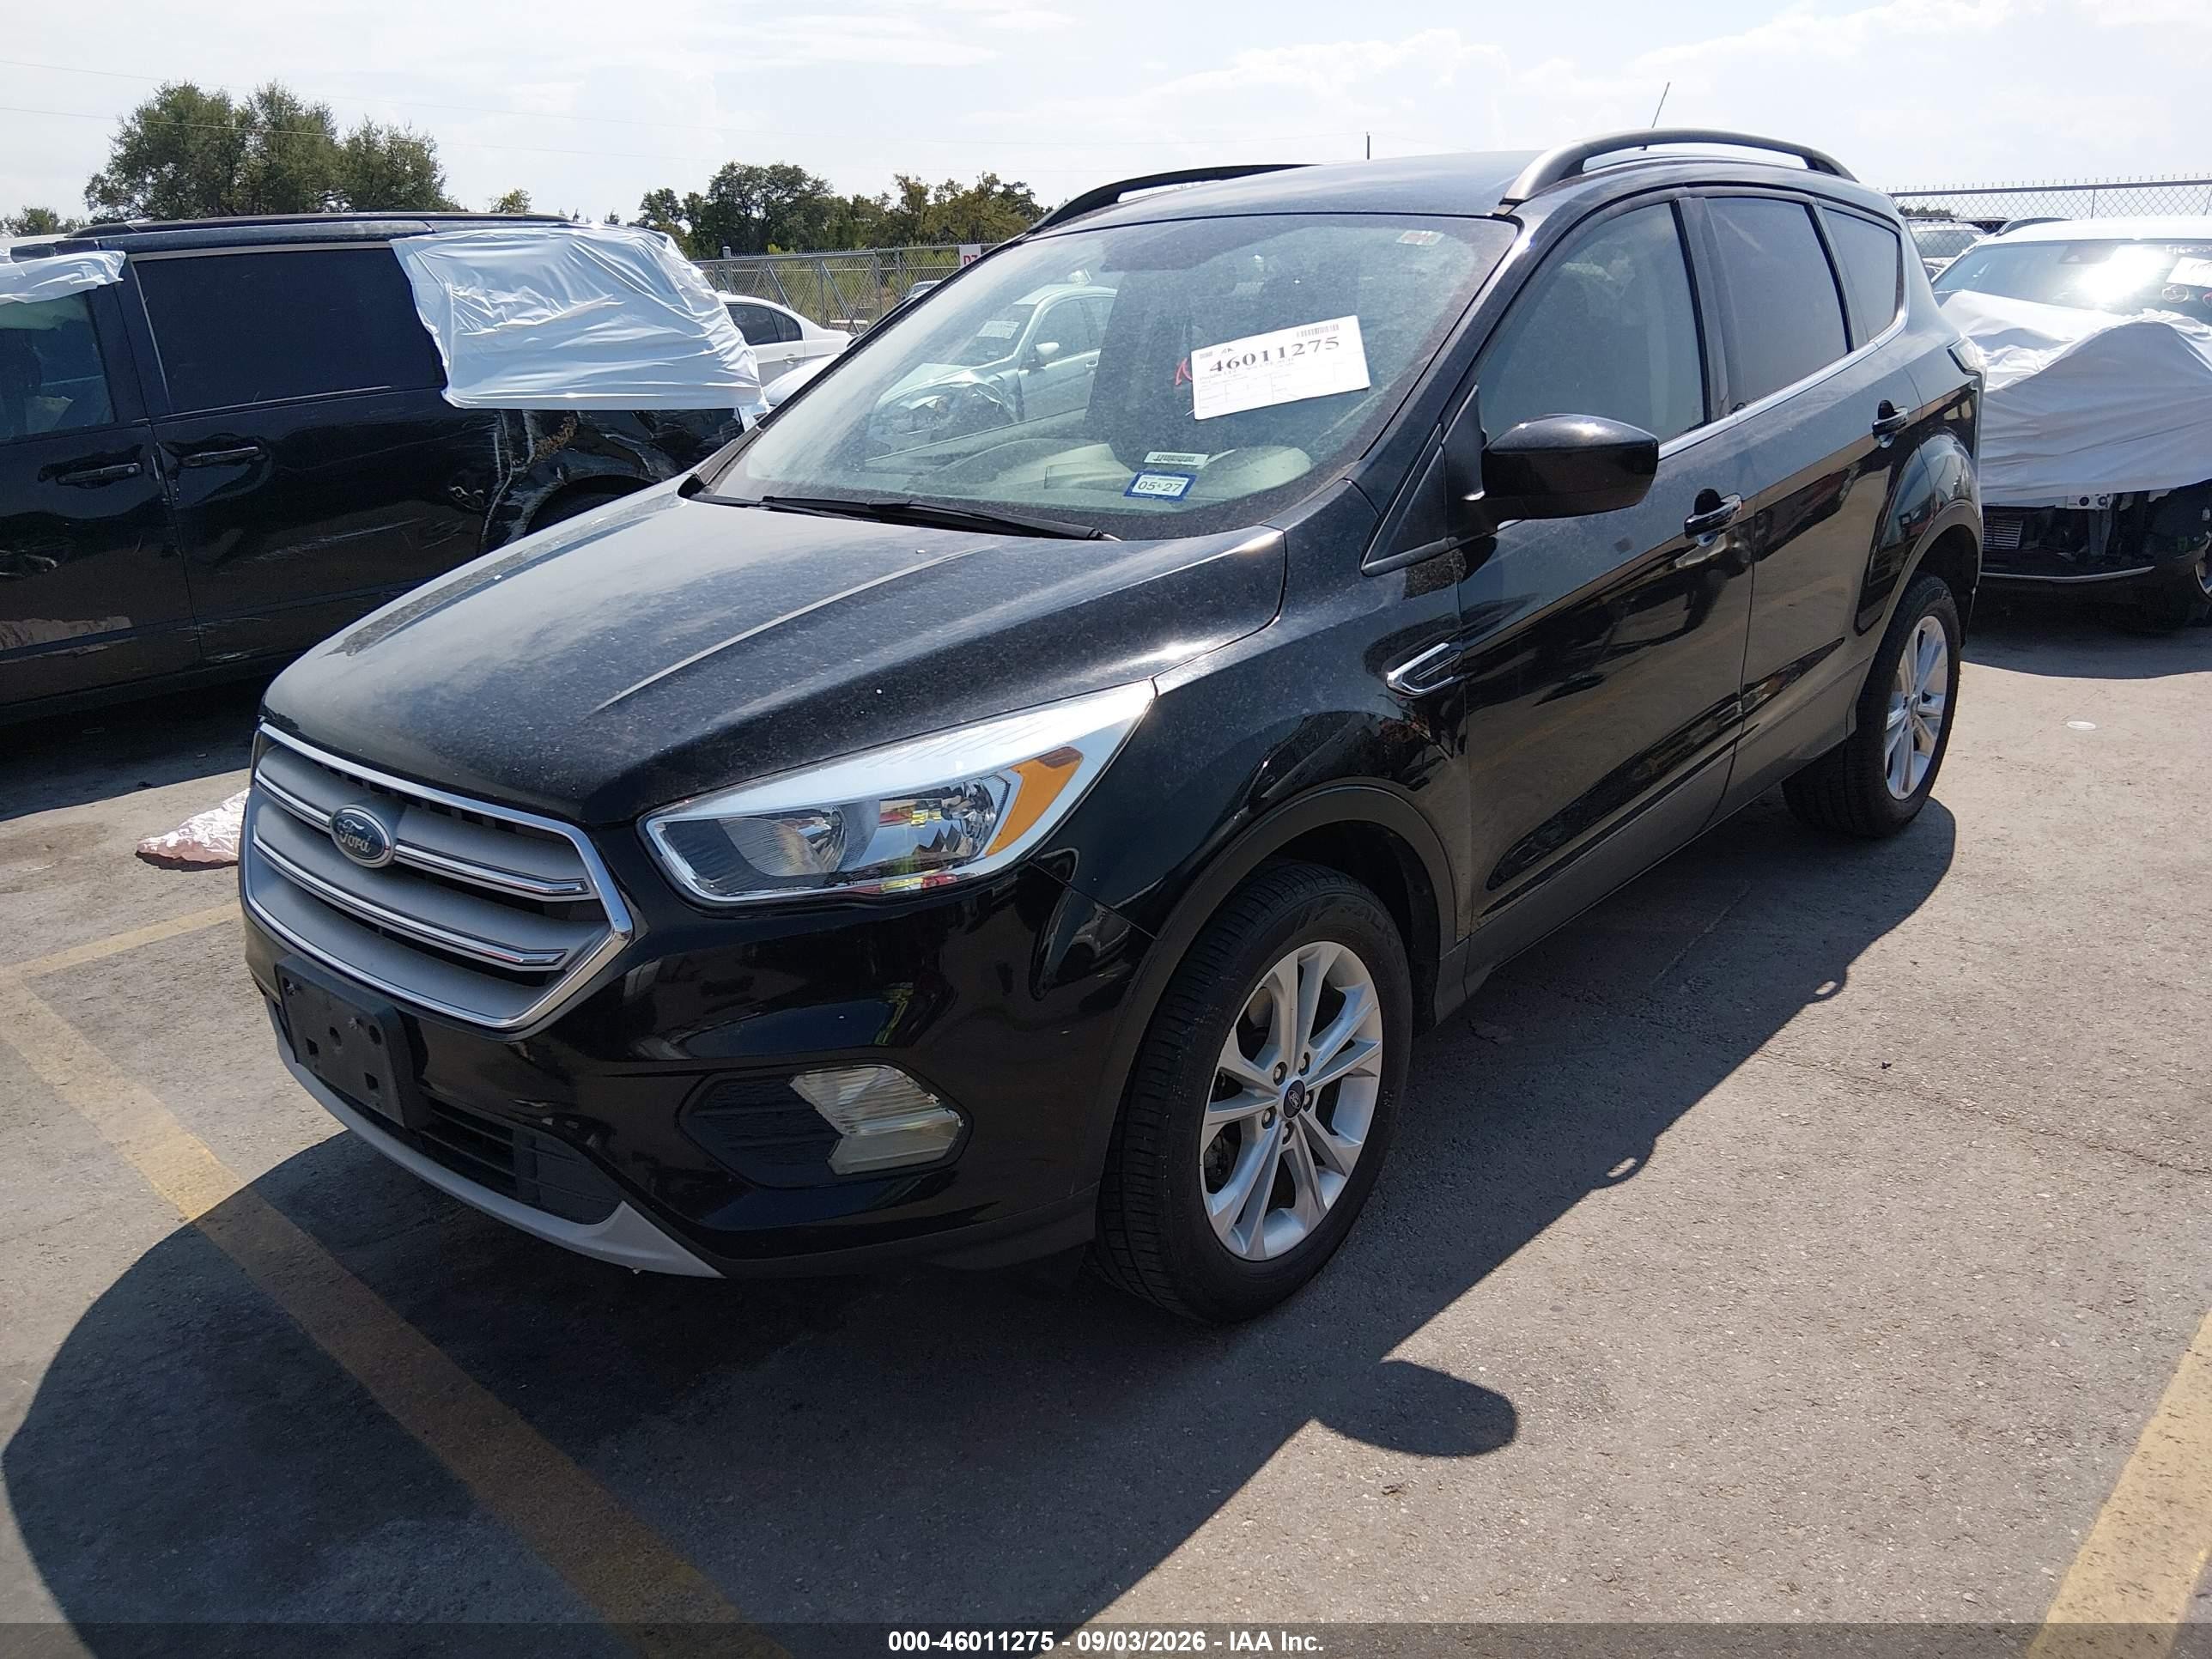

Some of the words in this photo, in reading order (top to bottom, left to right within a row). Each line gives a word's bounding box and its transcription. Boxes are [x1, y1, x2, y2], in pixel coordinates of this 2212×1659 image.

[1209, 336, 1340, 373] 46011275
[1138, 481, 1156, 491] 05
[1162, 483, 1182, 492] 27
[337, 818, 372, 853] Ford
